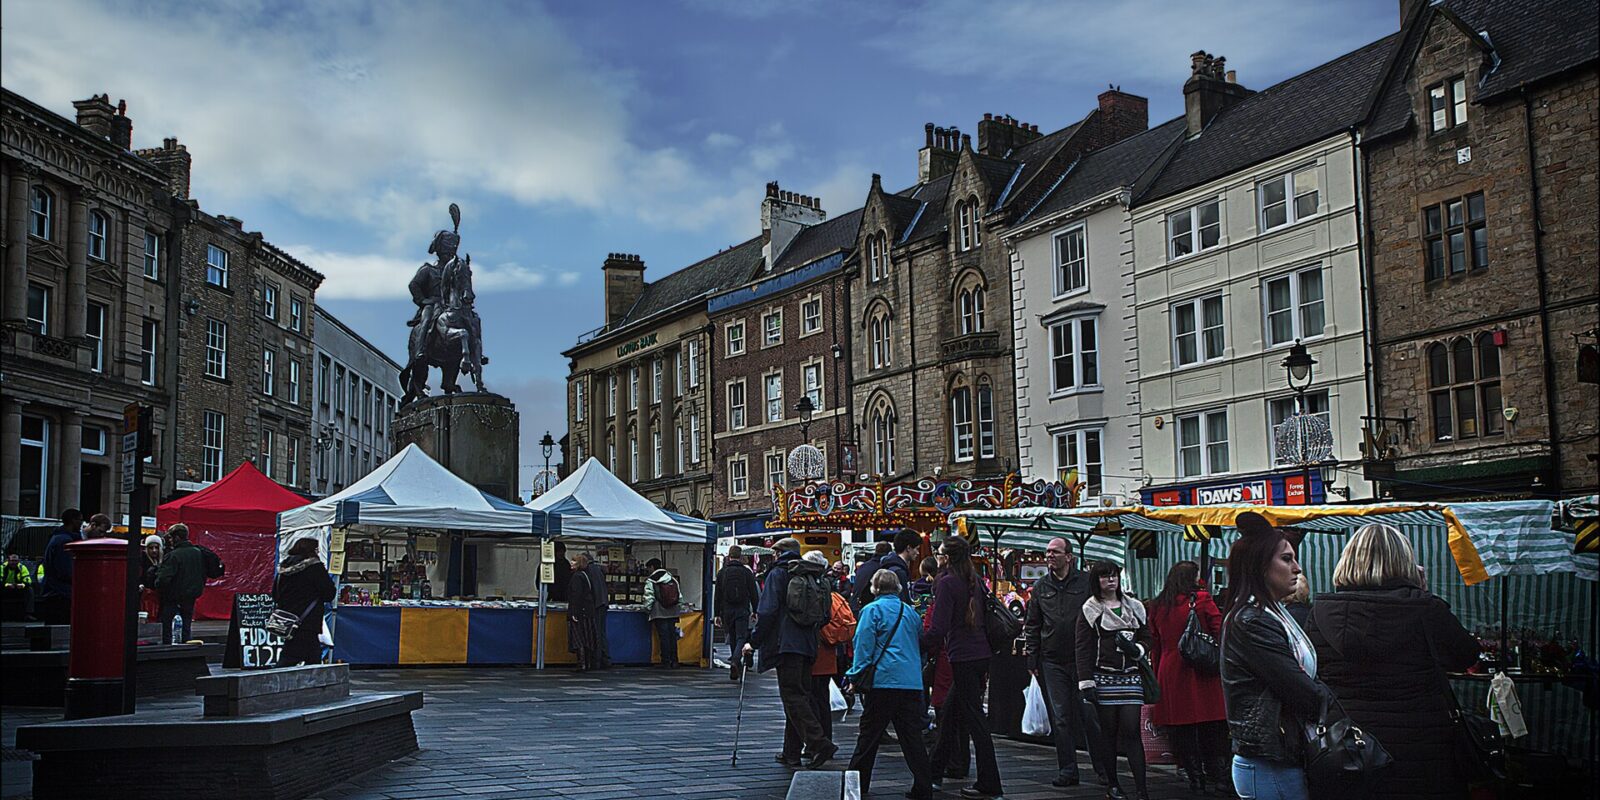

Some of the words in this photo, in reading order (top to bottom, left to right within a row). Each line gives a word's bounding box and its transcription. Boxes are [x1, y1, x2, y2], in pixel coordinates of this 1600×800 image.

[617, 340, 640, 358] LLOYDS
[640, 332, 658, 349] BANK
[1201, 485, 1264, 504] DAWSON
